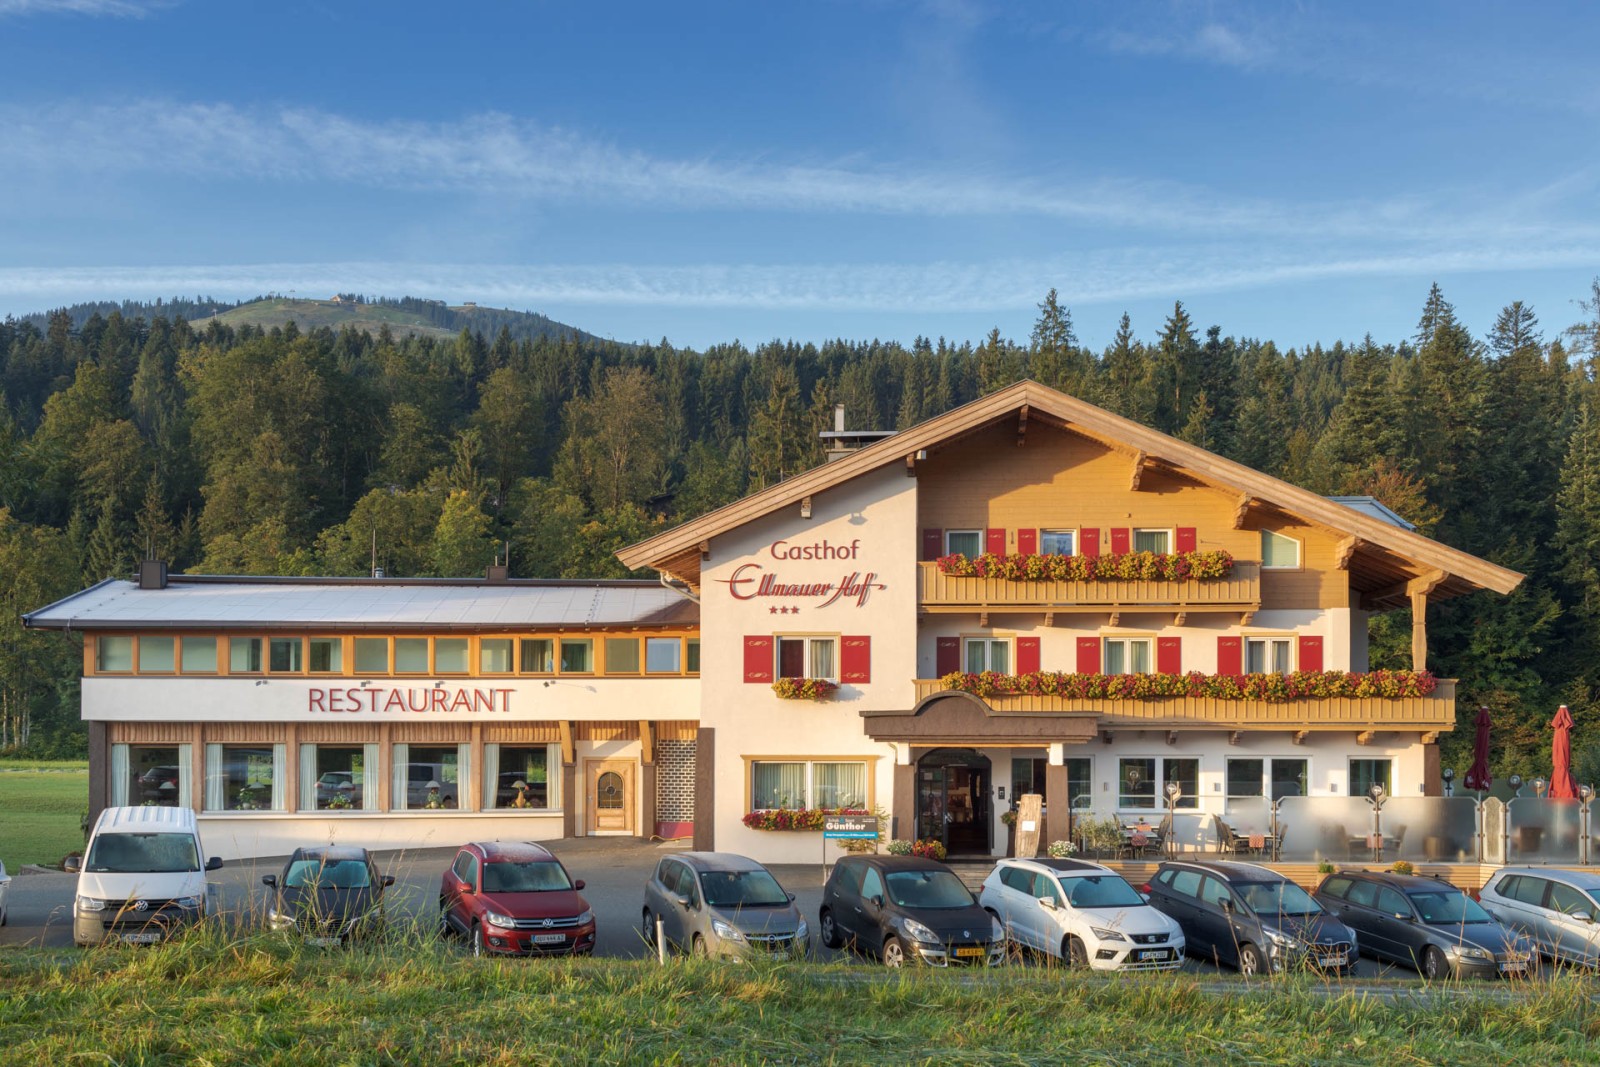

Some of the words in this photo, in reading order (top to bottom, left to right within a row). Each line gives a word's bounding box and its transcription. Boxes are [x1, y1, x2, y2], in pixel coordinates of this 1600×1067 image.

[770, 539, 861, 560] Gasthof
[713, 563, 831, 600] Ellmauer
[815, 572, 886, 608] Hof
[308, 688, 517, 712] RESTAURANT
